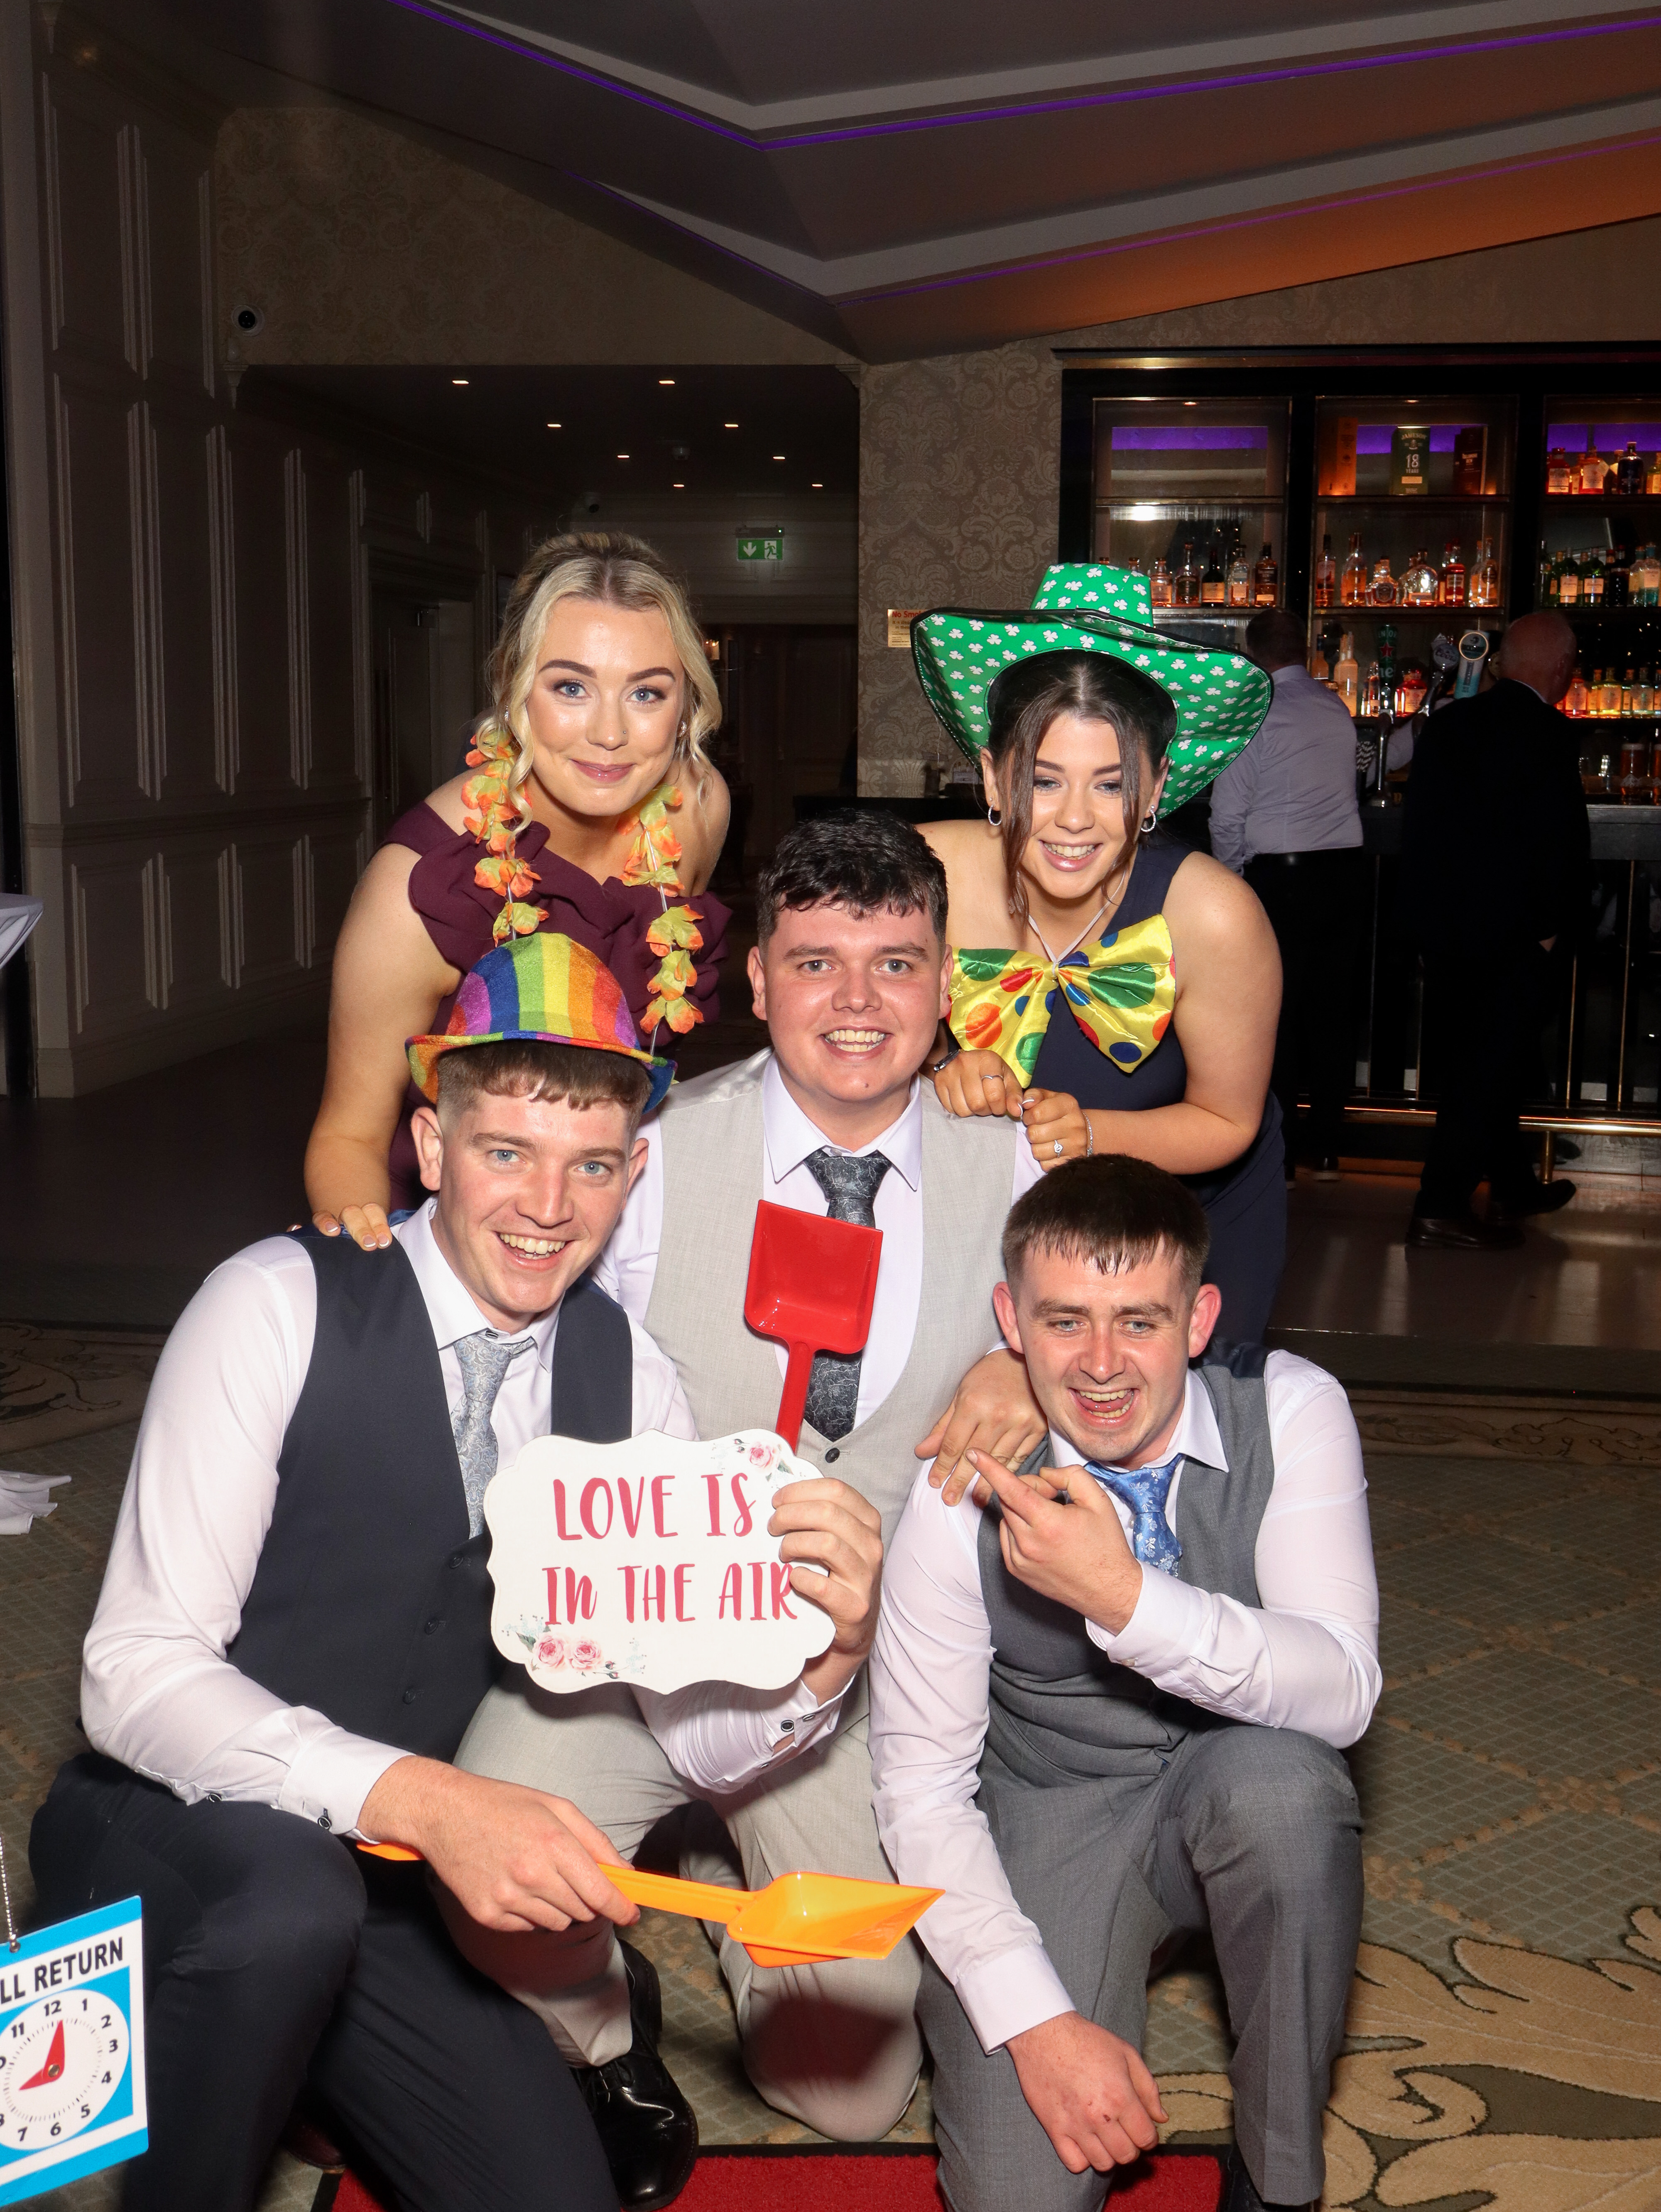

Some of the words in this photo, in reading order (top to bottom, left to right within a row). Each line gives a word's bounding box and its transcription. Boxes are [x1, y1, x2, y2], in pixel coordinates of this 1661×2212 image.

[1406, 454, 1419, 468] 18
[553, 1475, 679, 1541] LOVE
[701, 1472, 756, 1537] IS
[617, 1563, 695, 1622] THE
[719, 1561, 797, 1621] AIR
[0, 1974, 26, 2004] LL
[34, 1936, 123, 1992] RETURN
[44, 2000, 61, 2016] 12
[82, 1998, 88, 2011] 1
[101, 2015, 111, 2028] 2
[11, 2022, 24, 2038] 11
[109, 2039, 118, 2053] 3
[101, 2071, 112, 2084] 4
[81, 2104, 91, 2118] 5
[17, 2126, 27, 2142] 7
[50, 2122, 61, 2136] 6
